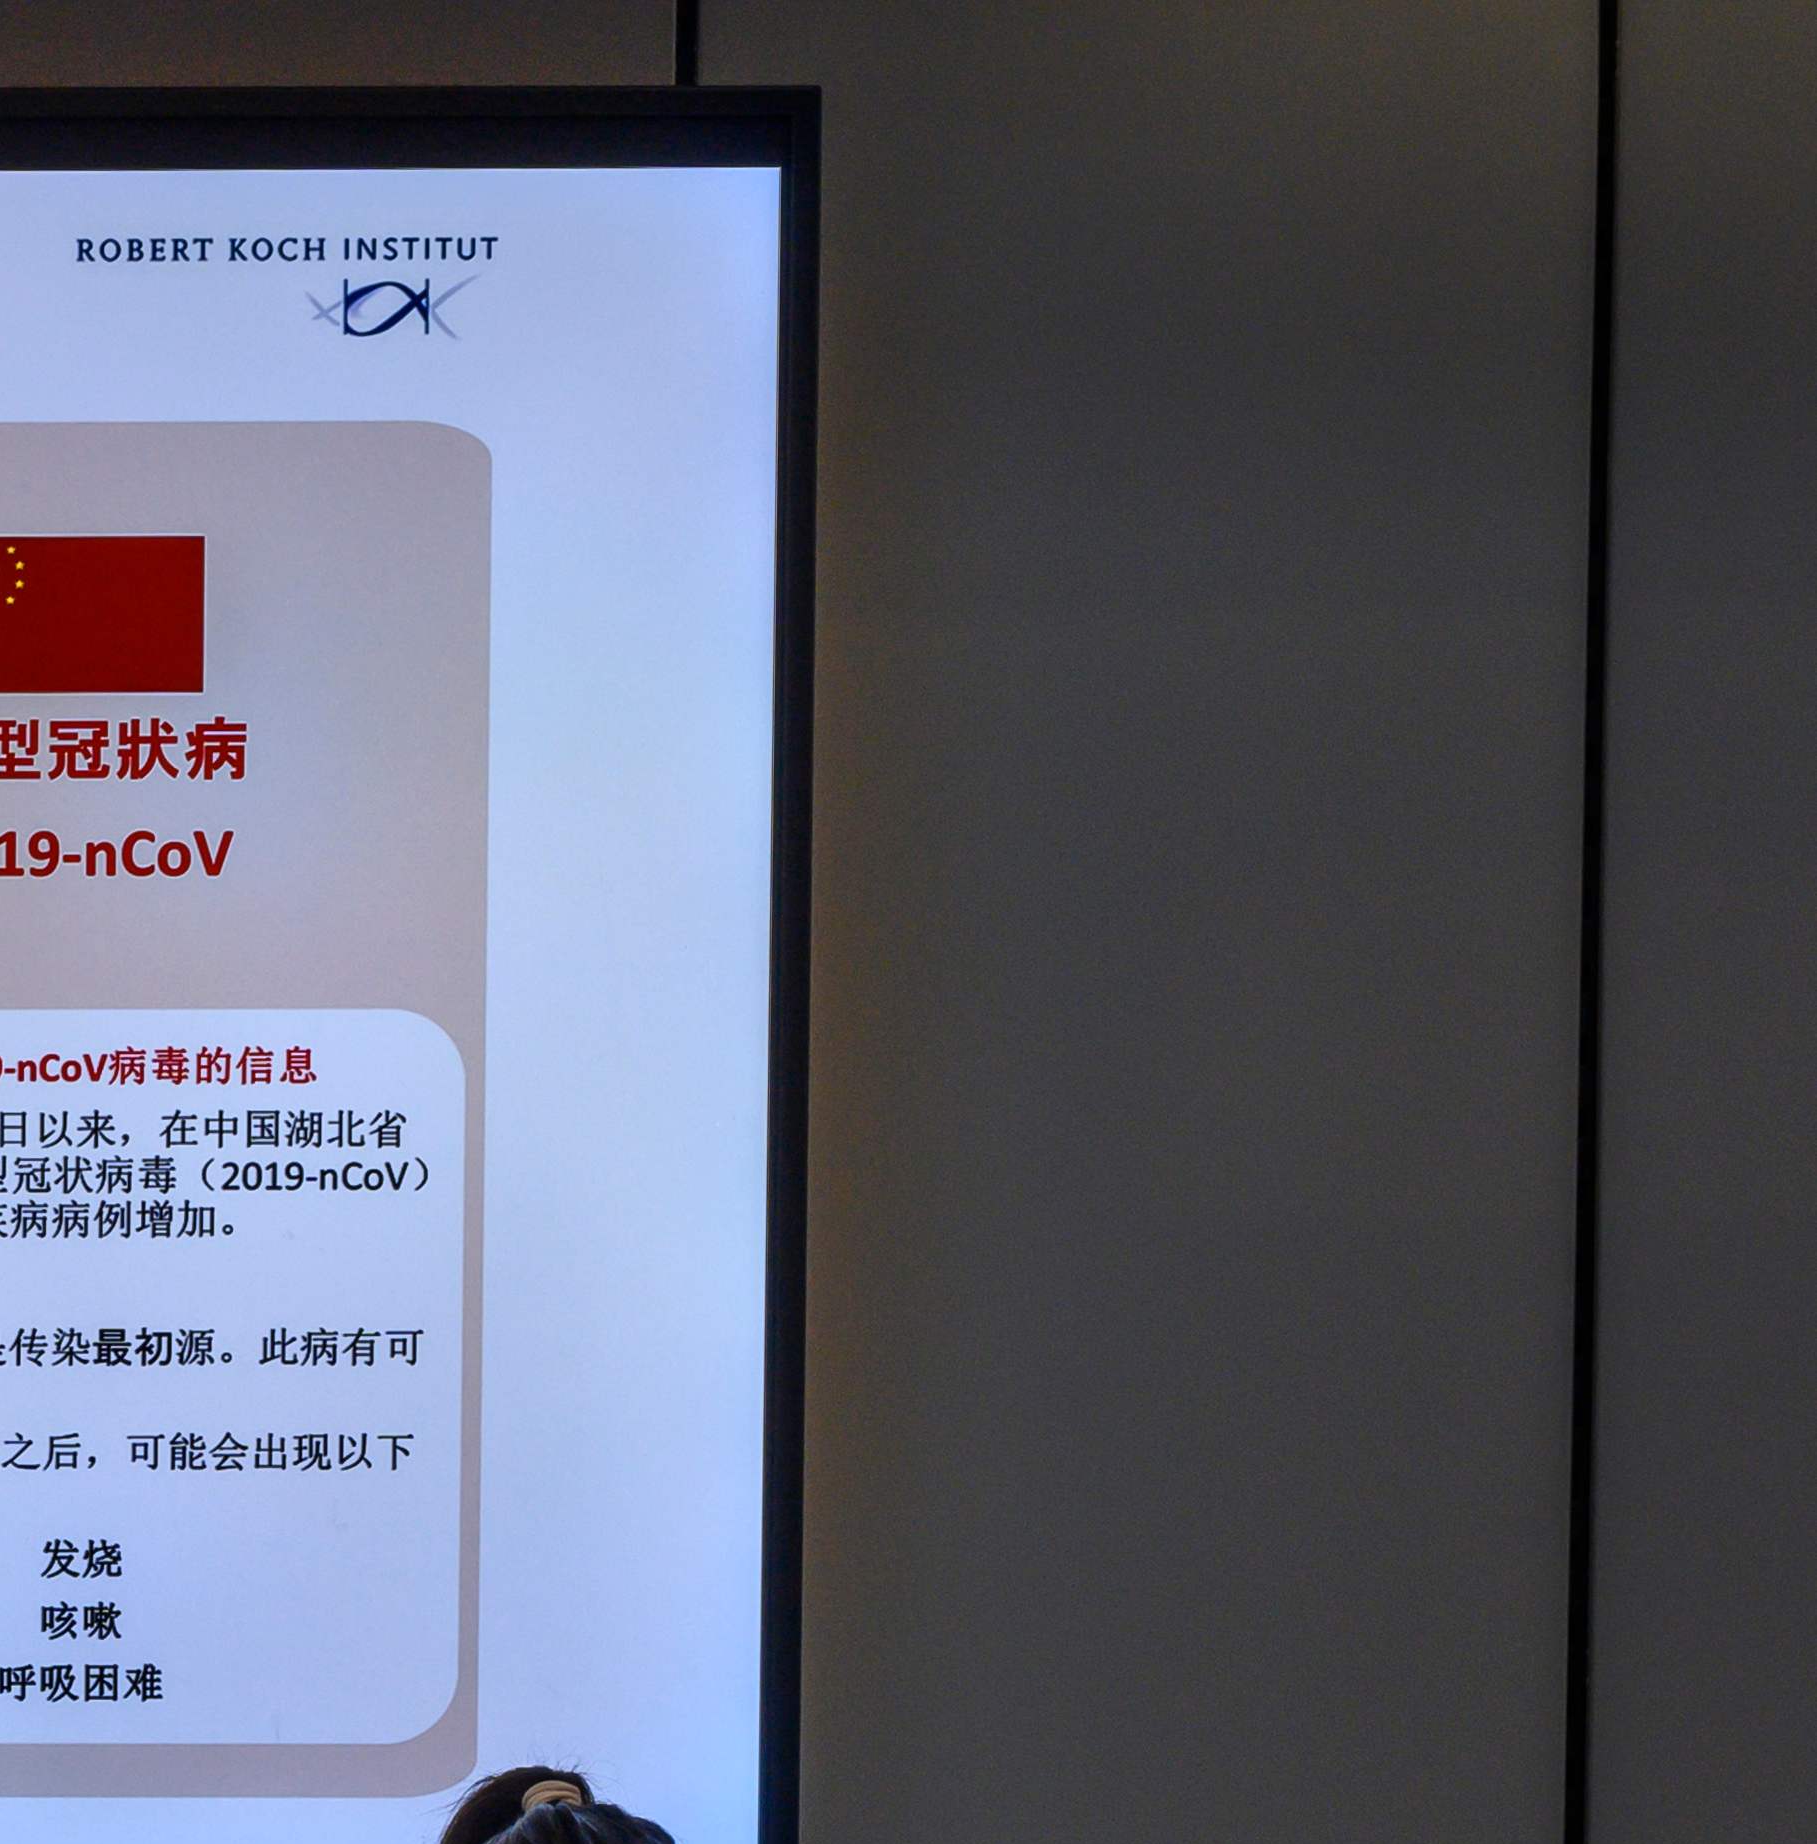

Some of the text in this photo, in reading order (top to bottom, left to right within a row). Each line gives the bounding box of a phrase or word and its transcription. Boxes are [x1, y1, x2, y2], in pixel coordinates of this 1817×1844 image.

[75, 236, 499, 263] ROBERT KOCH INSTITUT
[40, 1538, 123, 1580] 发烧
[40, 1600, 123, 1641] 咳嗽
